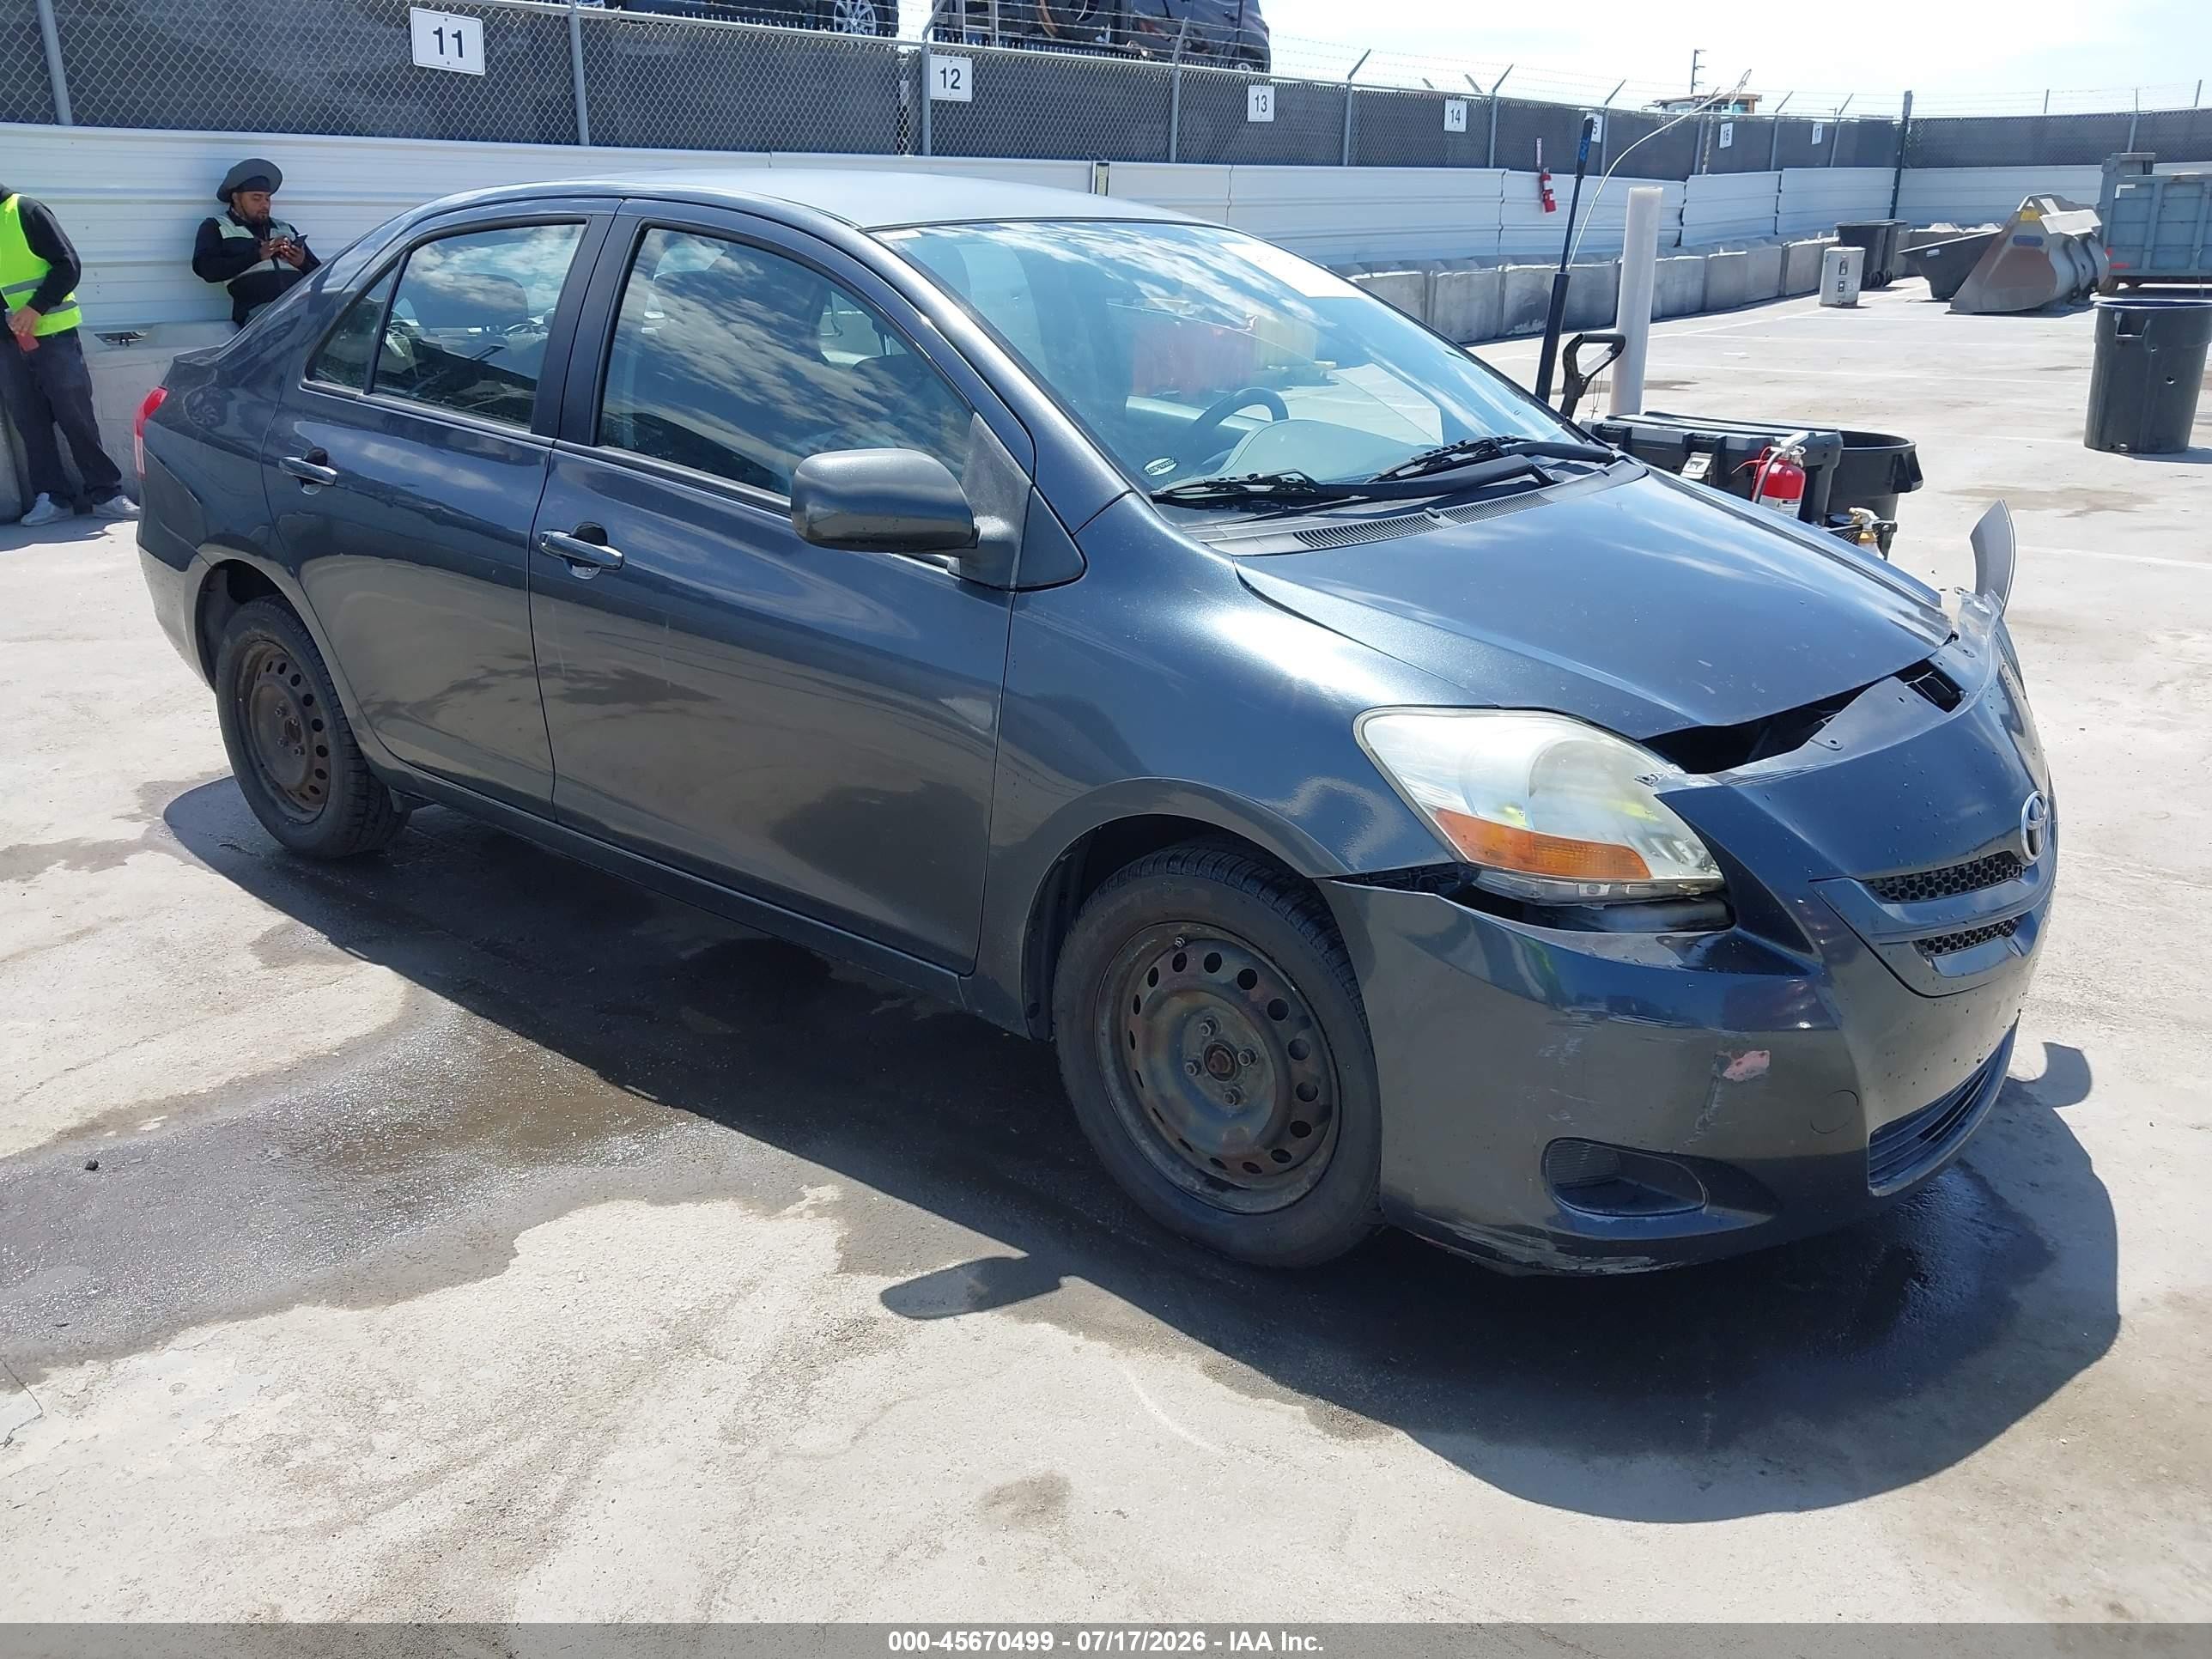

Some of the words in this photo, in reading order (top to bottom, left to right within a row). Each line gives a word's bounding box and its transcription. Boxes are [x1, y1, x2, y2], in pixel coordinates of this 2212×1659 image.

[432, 27, 464, 58] 11
[939, 67, 961, 90] 12
[1255, 94, 1267, 112] 13
[1450, 108, 1461, 124] 14
[1723, 129, 1729, 141] 16
